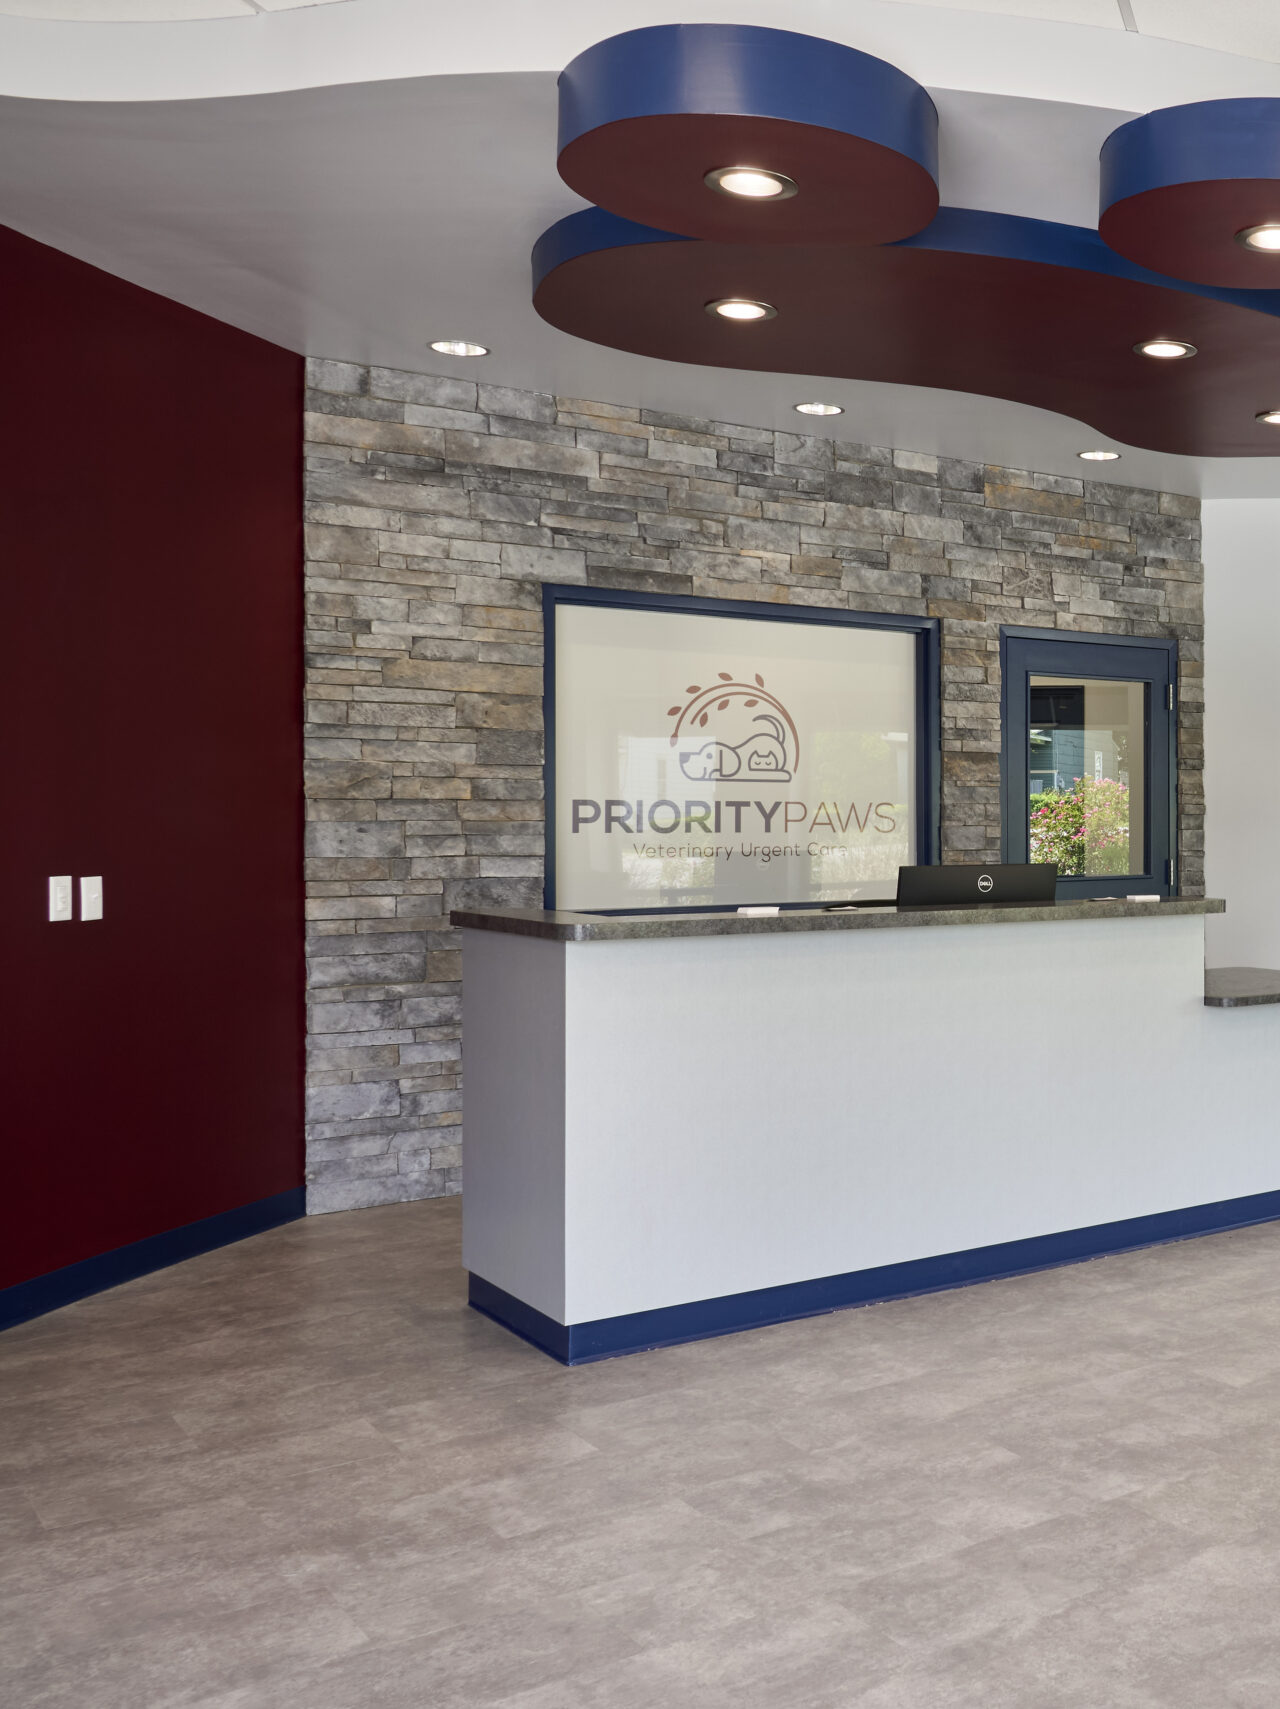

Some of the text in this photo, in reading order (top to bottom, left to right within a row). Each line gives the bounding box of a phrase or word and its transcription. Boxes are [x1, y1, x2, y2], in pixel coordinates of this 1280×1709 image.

[633, 841, 849, 863] Veterinary Urgent Care
